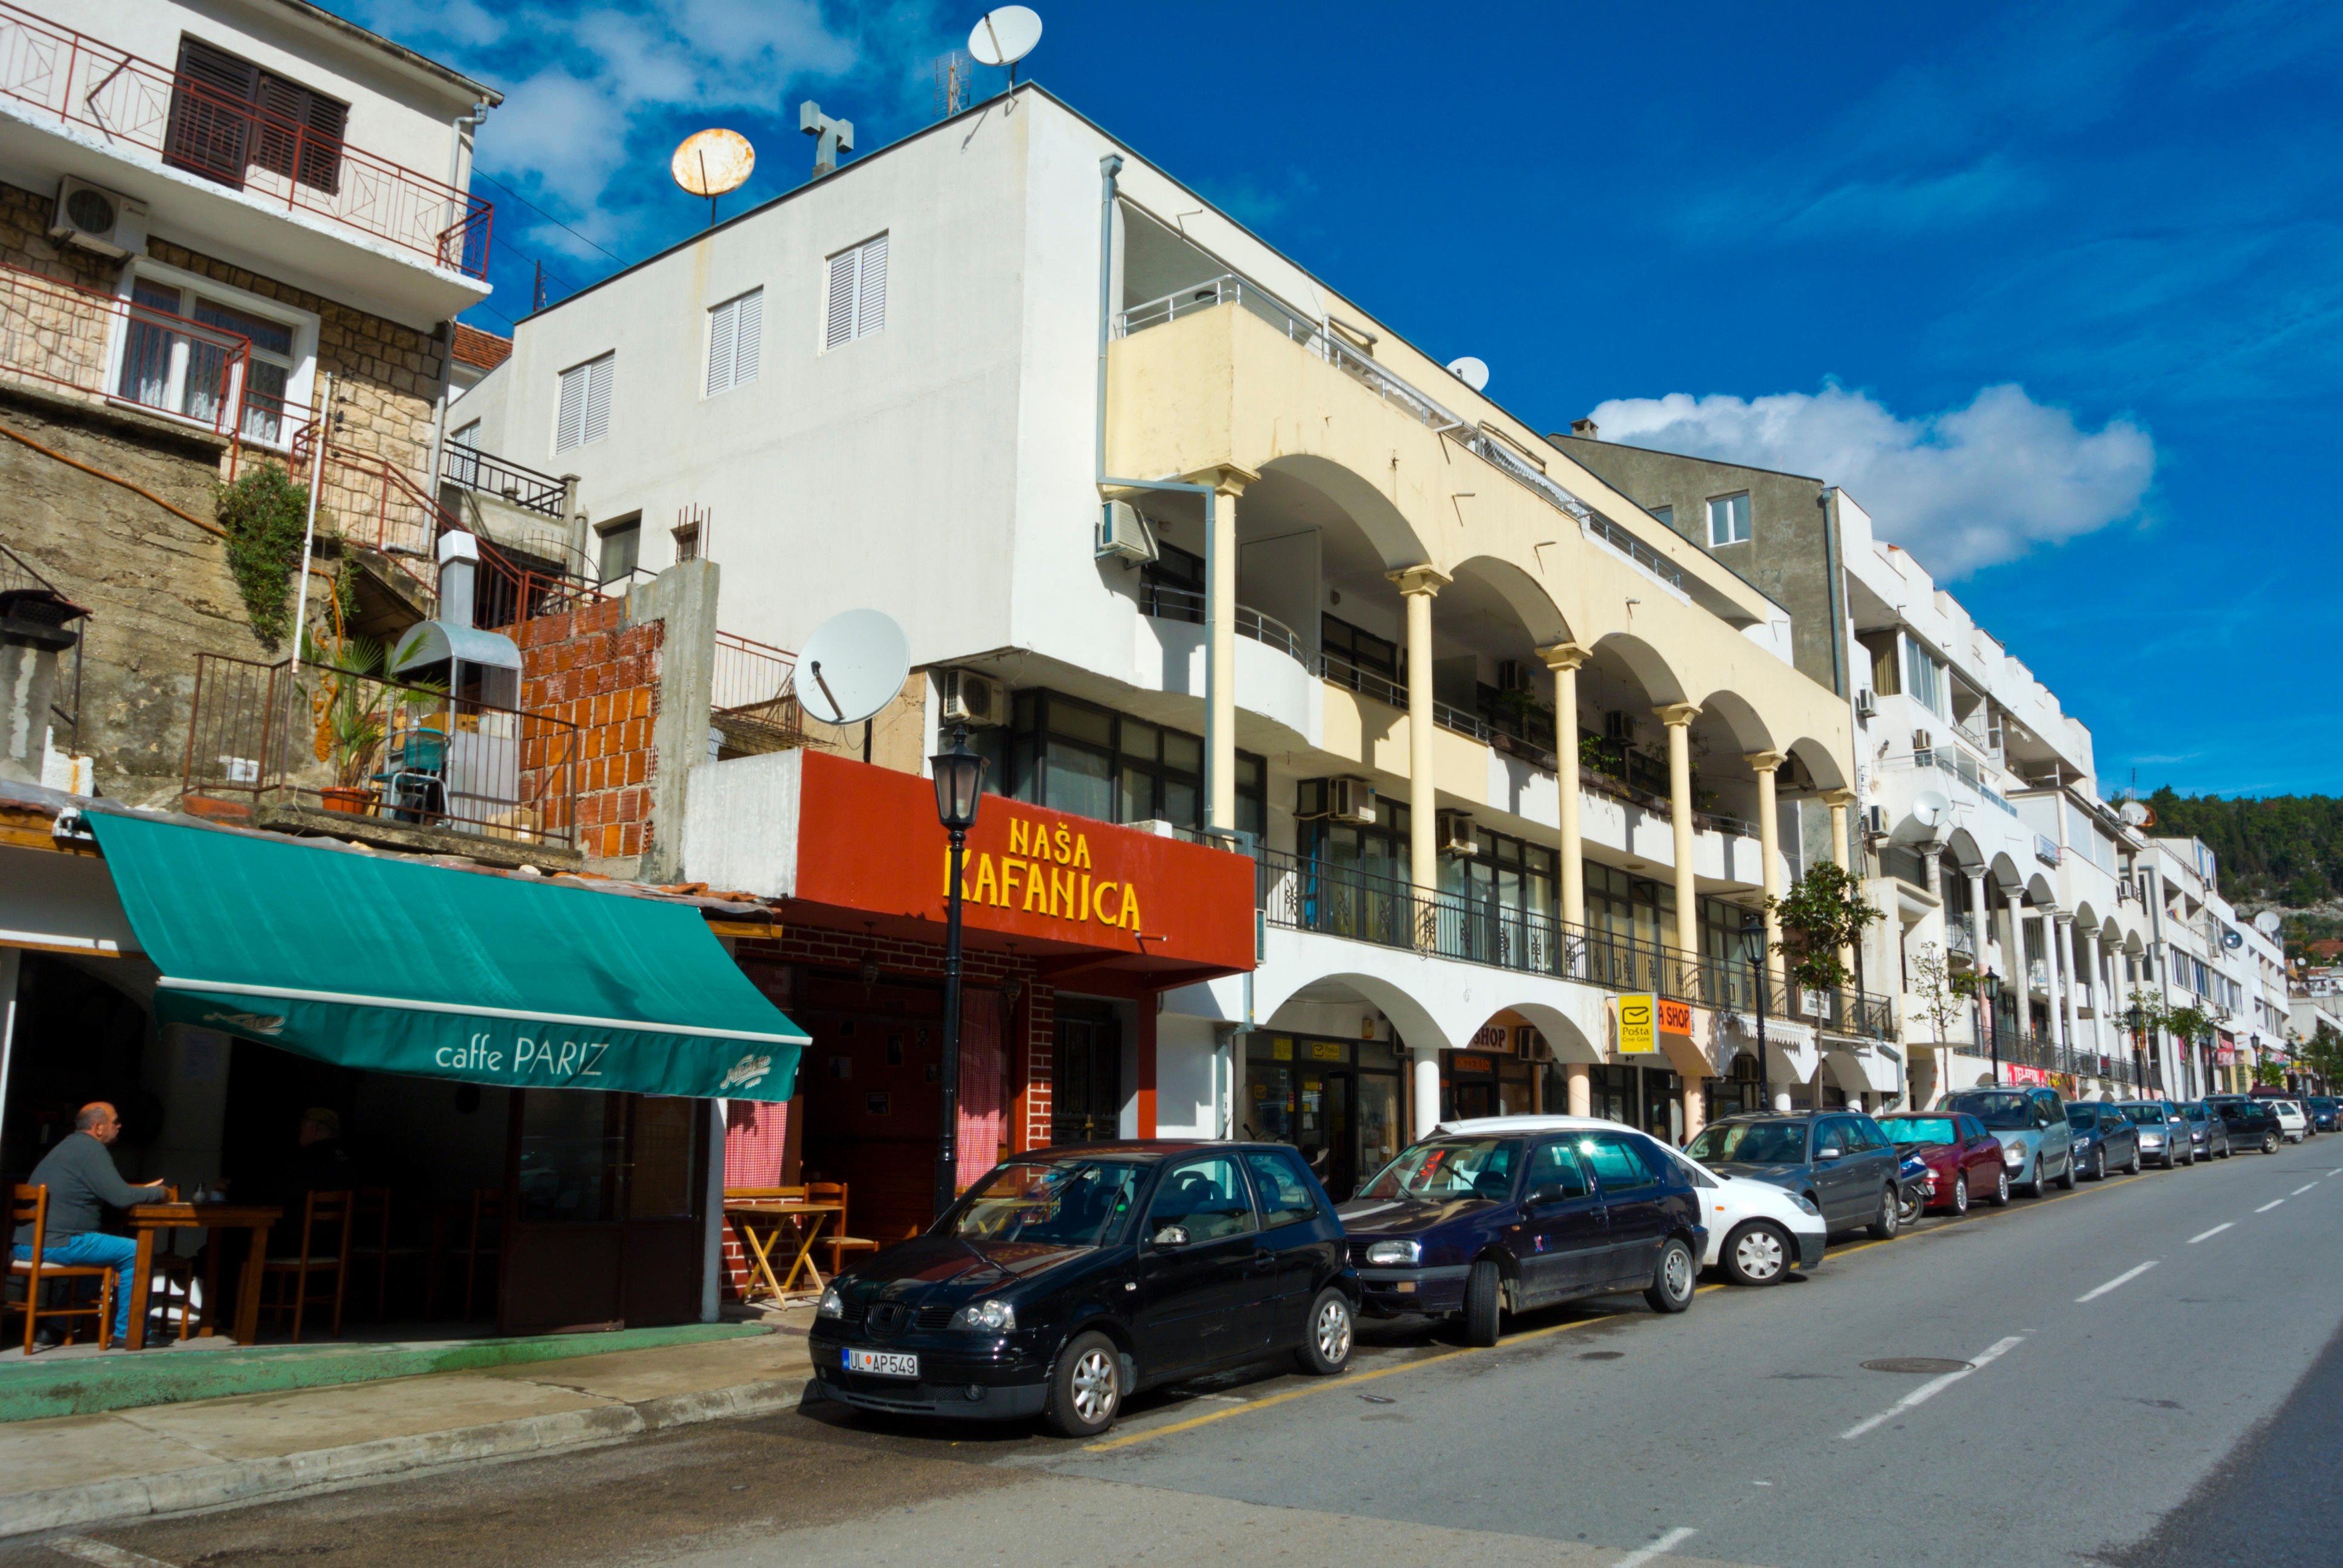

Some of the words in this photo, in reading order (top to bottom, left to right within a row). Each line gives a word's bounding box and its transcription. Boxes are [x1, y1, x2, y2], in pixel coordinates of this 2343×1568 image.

[1009, 817, 1091, 869] NAŠA
[1666, 1006, 1690, 1029] SHOP
[1622, 1026, 1650, 1036] Pošta
[436, 1033, 502, 1072] caffe
[513, 1037, 609, 1076] PARIZ
[850, 1352, 865, 1370] UL
[873, 1355, 915, 1374] AP549
